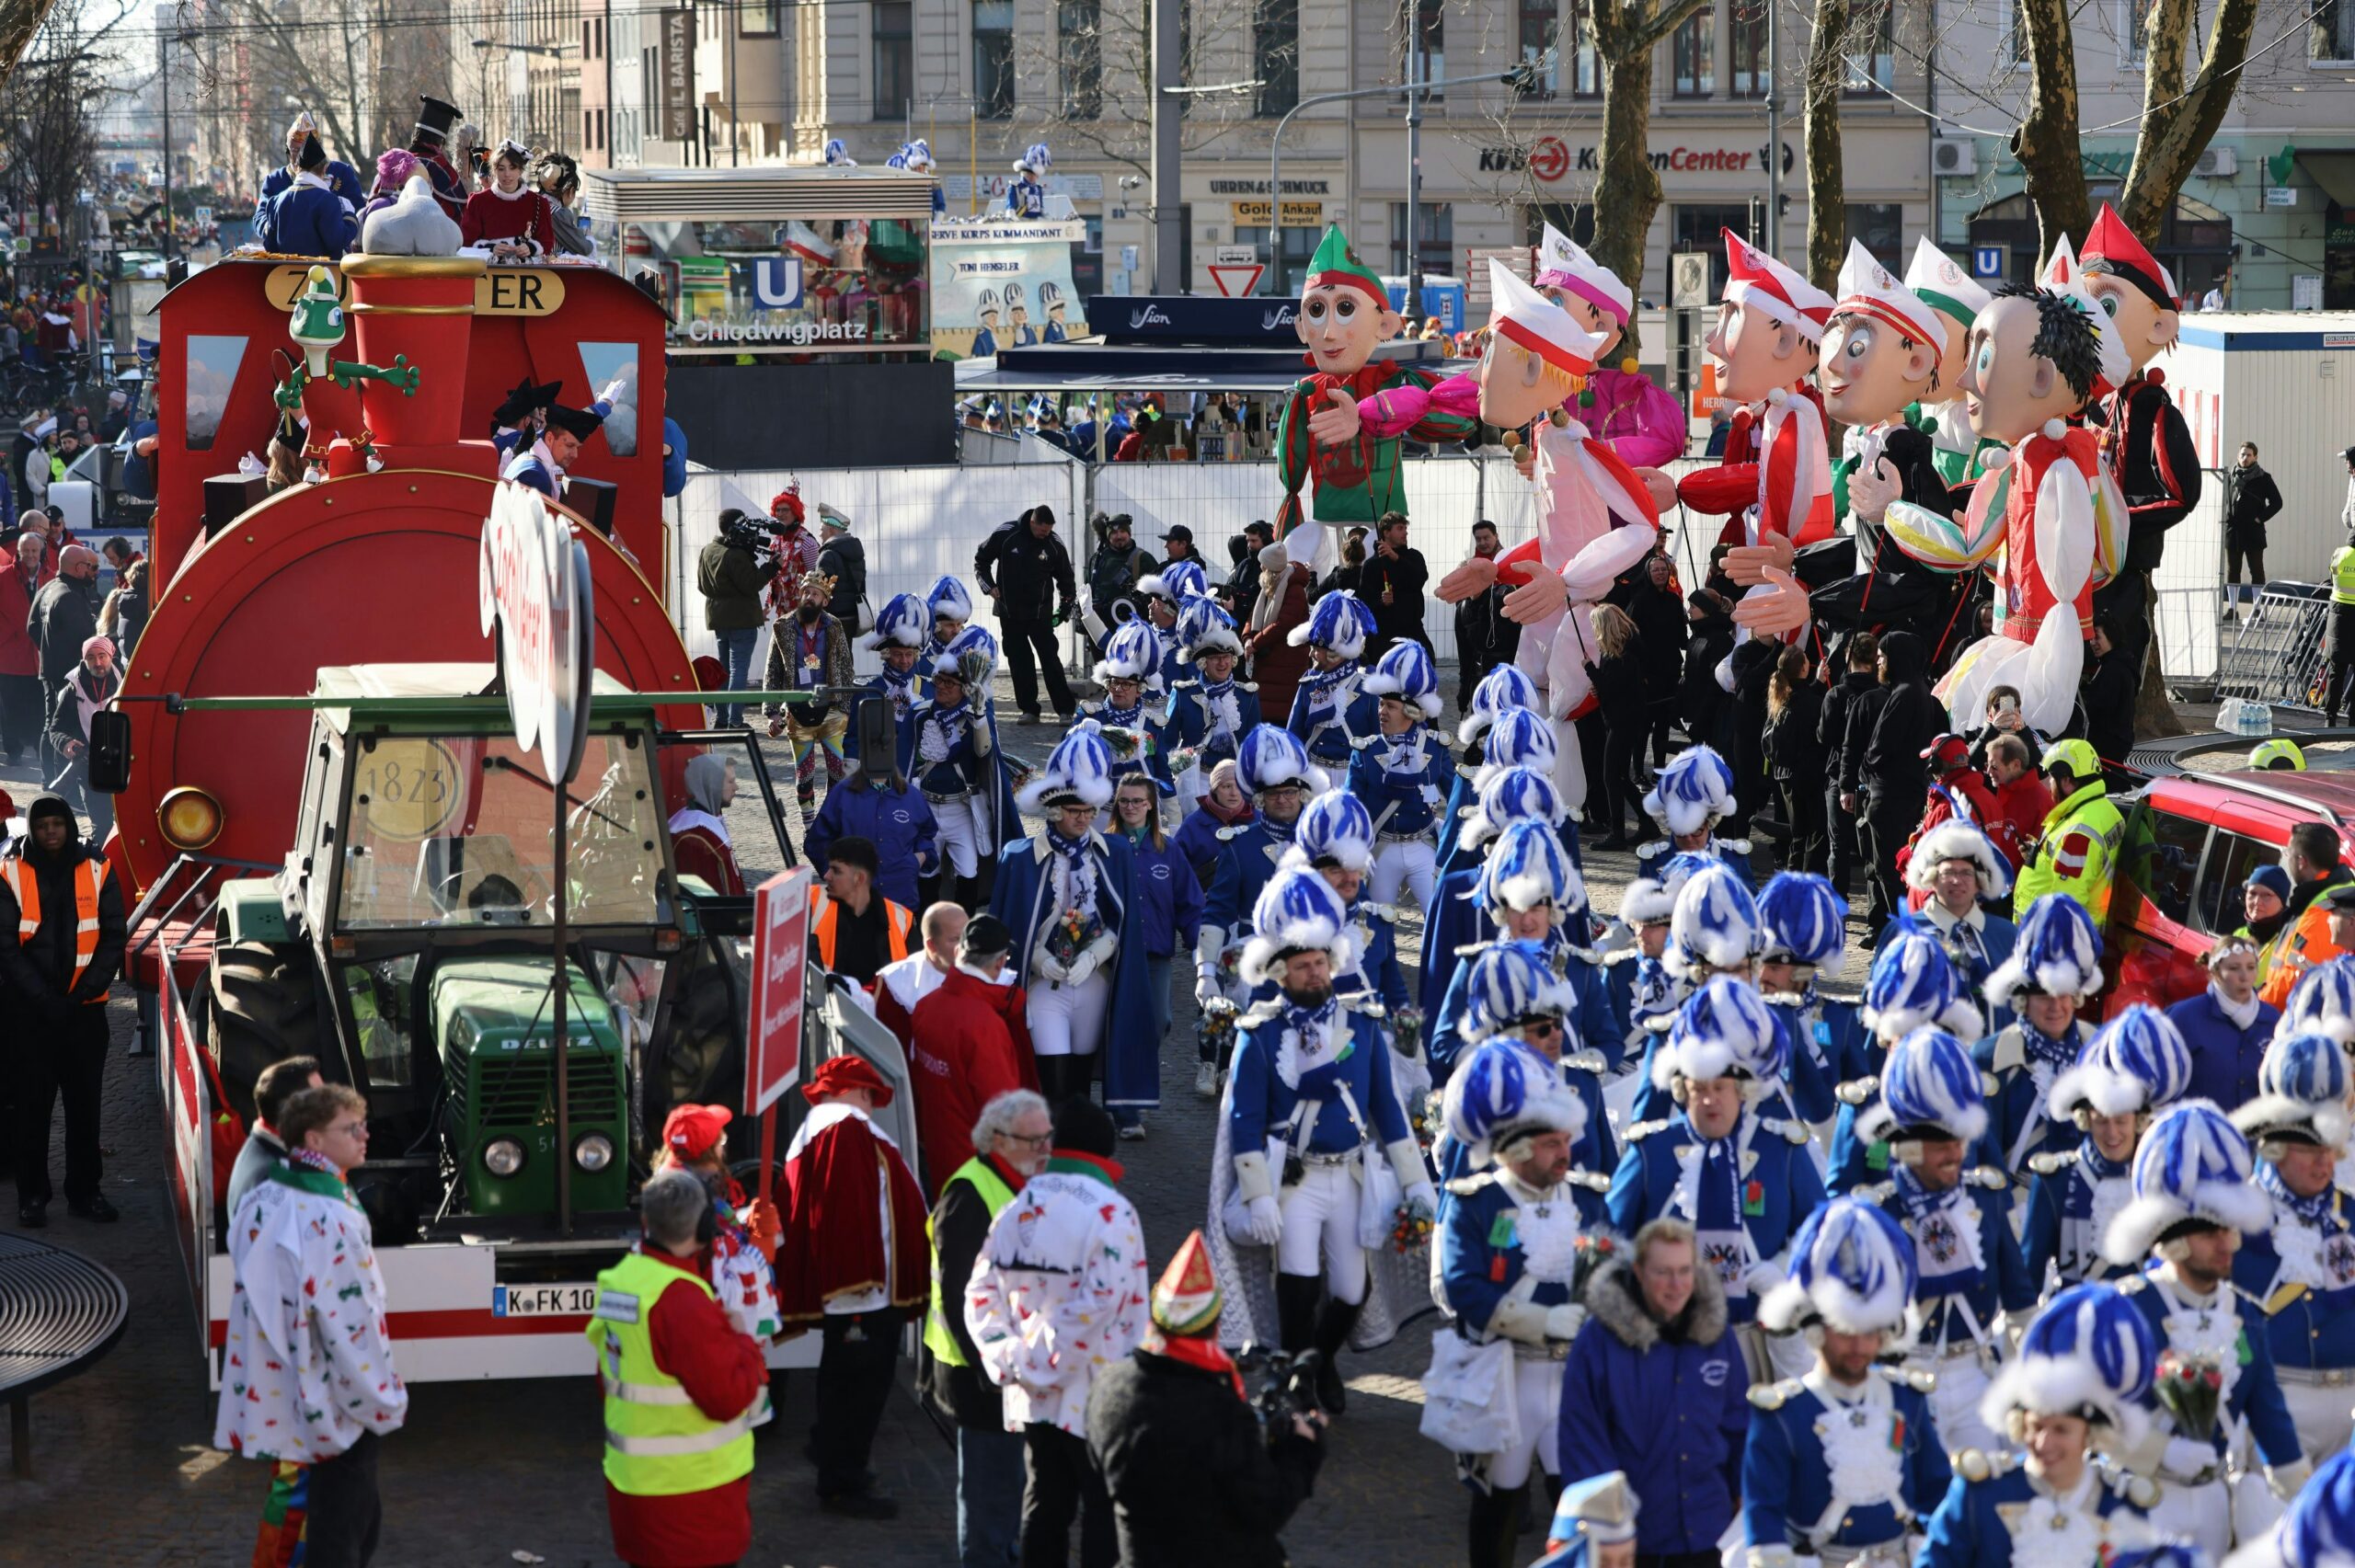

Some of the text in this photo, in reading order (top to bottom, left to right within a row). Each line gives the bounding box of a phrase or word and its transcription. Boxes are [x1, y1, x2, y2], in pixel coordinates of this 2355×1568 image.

[670, 15, 686, 136] Café IL BARISTA
[961, 230, 991, 239] KORPS
[994, 229, 1062, 239] KOMMANDANT
[959, 262, 1020, 272] TONI HENSELER
[1979, 251, 1997, 273] U
[756, 261, 799, 306] U
[1130, 303, 1171, 329] Sion
[689, 319, 867, 346] Chlodwigplatz
[367, 761, 445, 803] 1823
[509, 1290, 522, 1313] K
[537, 1289, 563, 1312] FK
